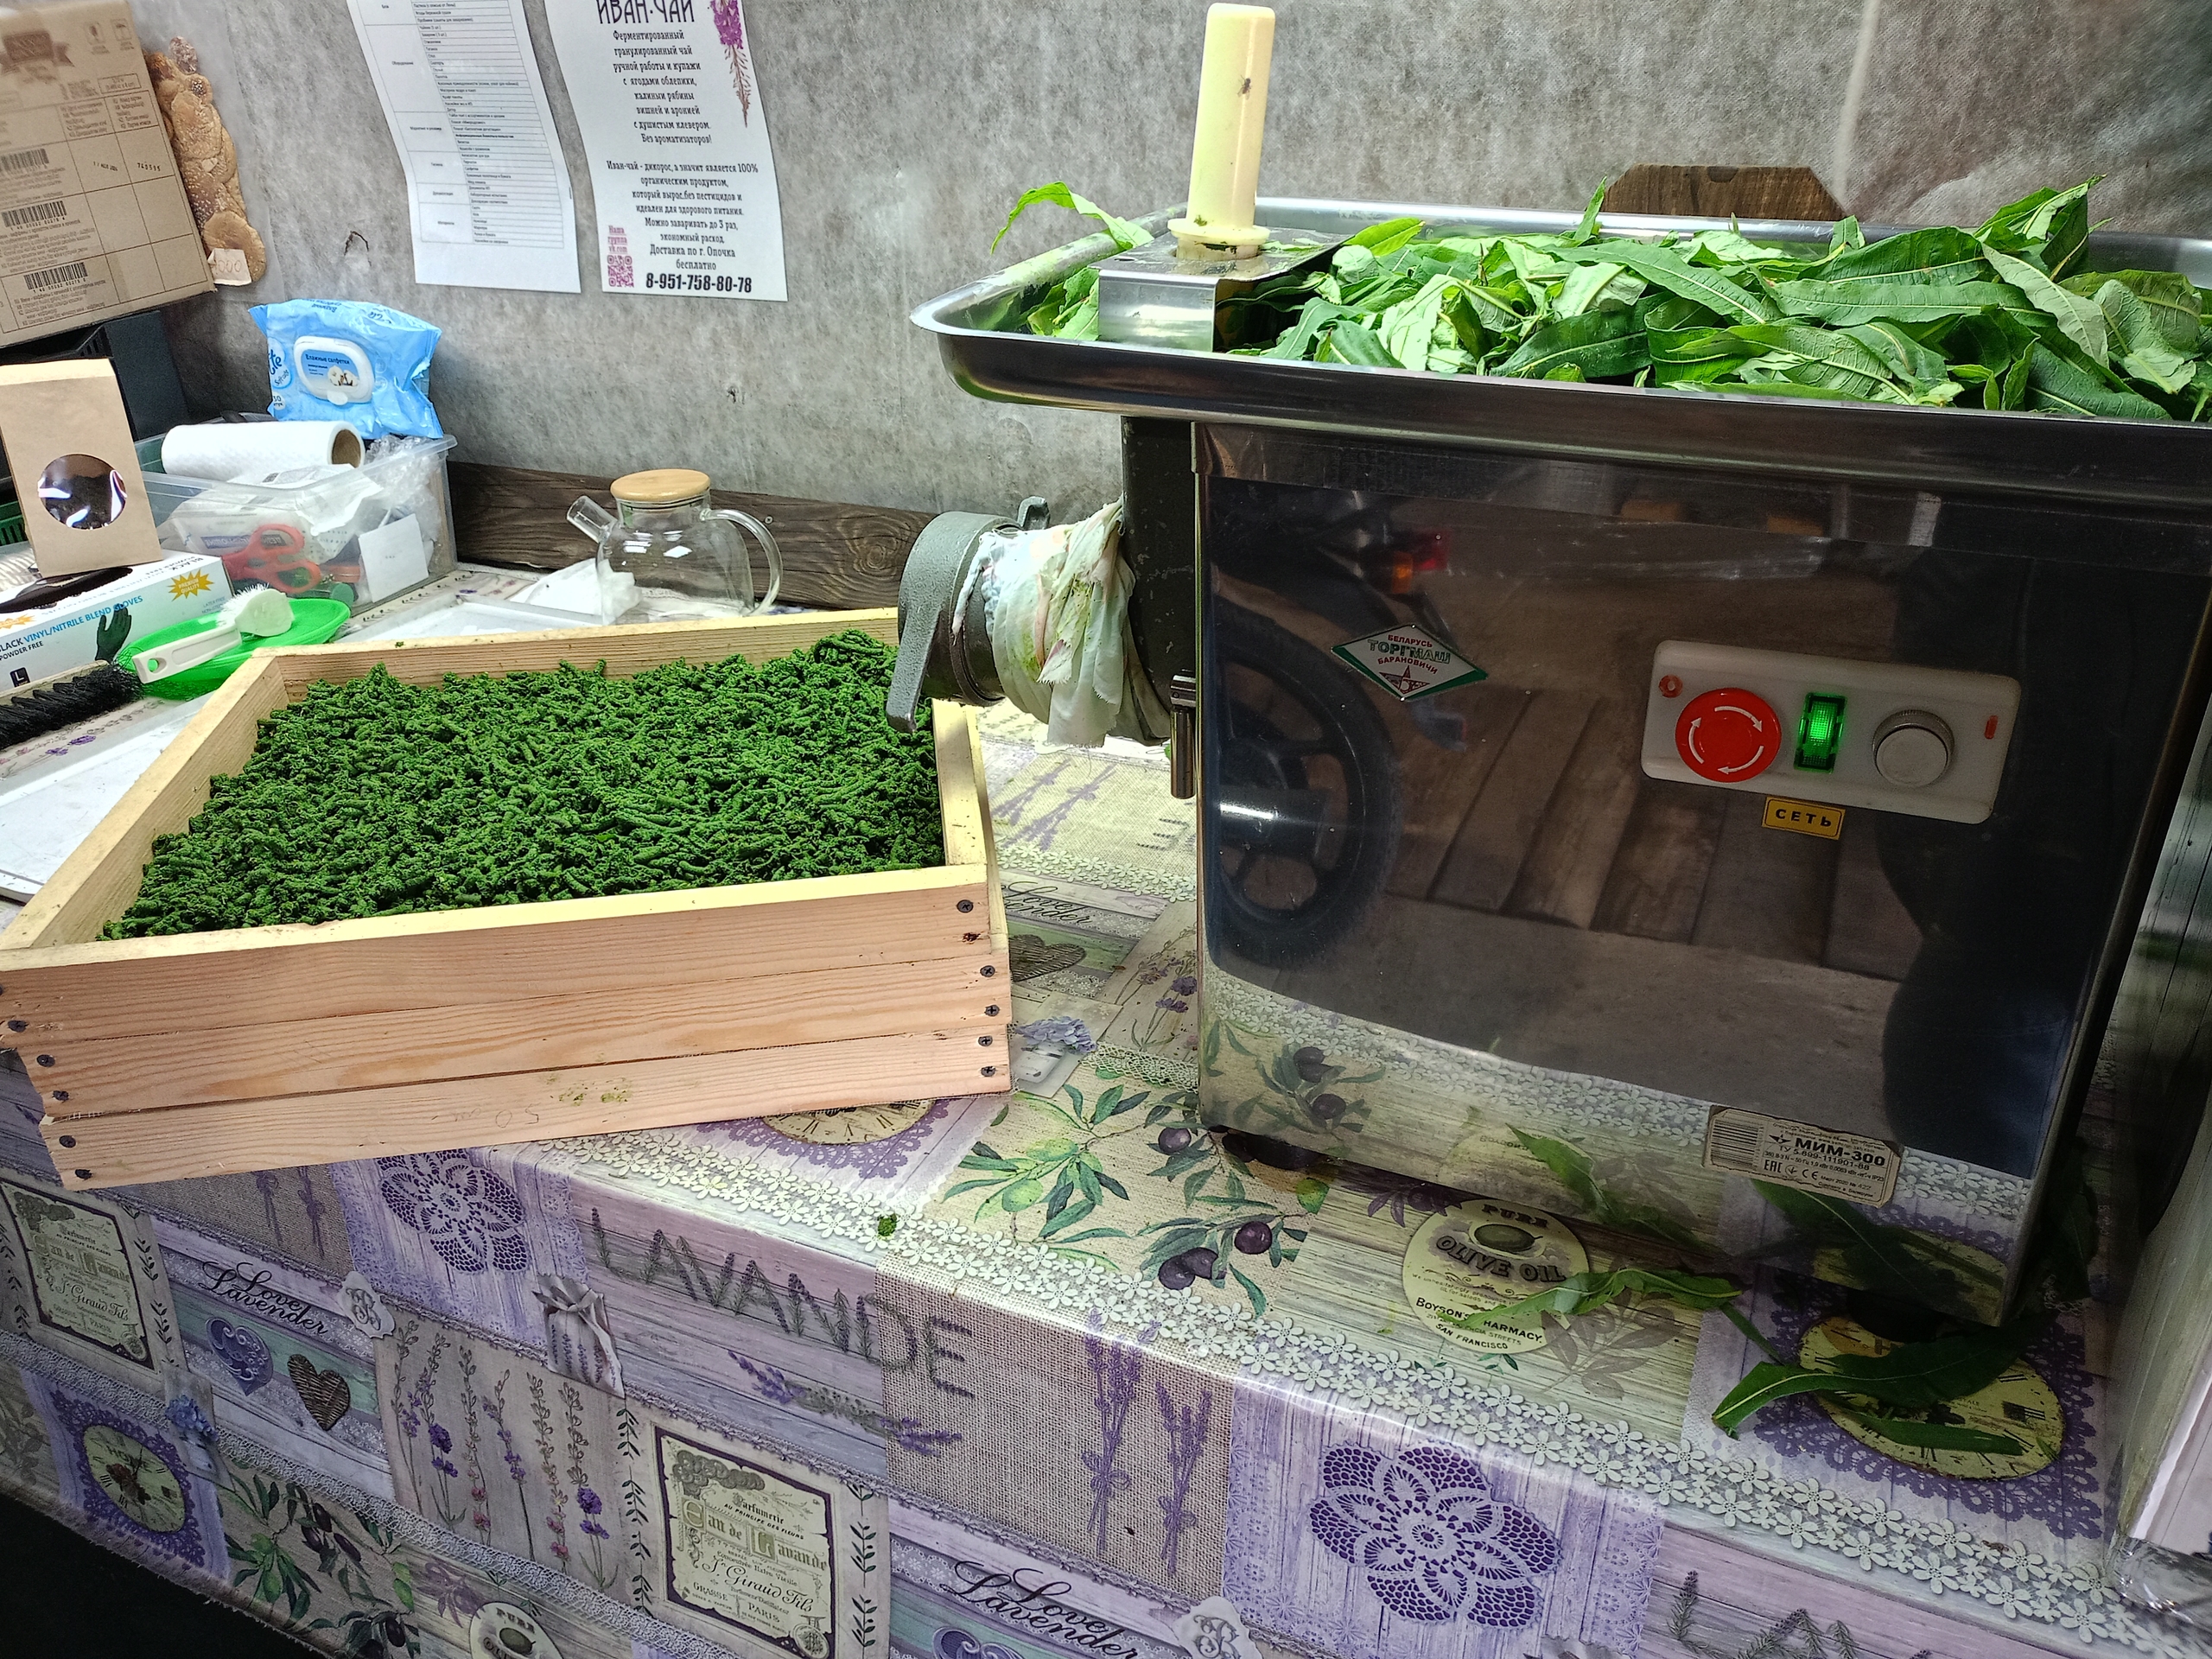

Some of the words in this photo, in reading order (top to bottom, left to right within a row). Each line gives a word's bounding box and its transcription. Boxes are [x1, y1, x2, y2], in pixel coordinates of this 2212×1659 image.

[613, 30, 684, 42] Ферментированный
[614, 46, 677, 58] гранулированный
[678, 45, 693, 55] чай
[613, 61, 639, 73] ручной
[639, 60, 665, 73] работы
[673, 62, 701, 73] купажи
[630, 78, 660, 86] ягодами
[661, 76, 697, 86] облепихи,
[667, 91, 695, 102] рябины
[636, 105, 664, 115] вишней
[665, 105, 670, 114] и
[671, 105, 700, 117] аронией
[639, 121, 674, 130] душистым
[676, 122, 711, 131] клевером.
[641, 133, 653, 143] Без
[654, 134, 712, 145] ароматизаторов!
[607, 160, 639, 170] Иван-чай
[645, 162, 674, 173] дикорос,
[705, 164, 737, 173] является
[738, 163, 759, 173] 100%
[640, 176, 689, 187] органическим
[690, 178, 729, 188] продуктом,
[632, 190, 662, 200] который
[696, 193, 735, 202] пестицидов
[636, 204, 664, 213] идеален
[664, 206, 677, 214] для
[678, 206, 712, 216] здорового
[608, 226, 625, 234] Наша
[645, 217, 669, 227] Можно
[671, 219, 708, 230] заваривать
[709, 221, 718, 230] до
[719, 219, 723, 229] 3
[726, 221, 738, 232] раз,
[607, 236, 627, 245] группа
[660, 232, 699, 242] экономный
[608, 245, 627, 253] vk.com
[650, 244, 686, 256] Доставка
[687, 246, 696, 256] по
[707, 246, 736, 257] Опочка
[676, 259, 716, 270] бесплатно
[645, 272, 753, 293] 8-951-758-80-78
[305, 353, 327, 362] Влажные
[328, 355, 350, 365] салфетки
[23, 615, 85, 643] VINYL/NITRILE
[85, 607, 111, 621] BLEND
[112, 595, 143, 613] GLOVES
[28, 640, 44, 651] FREE
[1388, 634, 1433, 647] БЕЛАРУСЬ
[1367, 639, 1451, 664] ТОРГМАШ
[1377, 658, 1438, 674] БАРАНОВИЧИ
[15, 671, 25, 682] L
[1775, 808, 1832, 828] СЕТЬ
[1795, 1137, 1885, 1166] МИМ-300
[1793, 1148, 1870, 1171] 5.899-111901-88
[1481, 1204, 1549, 1228] PURE
[1436, 1236, 1512, 1278] OLIVE
[1519, 1263, 1567, 1282] OIL
[231, 1262, 302, 1313] Love
[71, 1284, 108, 1312] Giraud
[108, 1303, 130, 1322] Fils
[198, 1261, 328, 1335] Lavender
[1435, 1324, 1453, 1338] SAN
[1456, 1333, 1509, 1350] FRANCISCO
[1483, 1319, 1542, 1344] HARMACY.
[1488, 1331, 1522, 1345] STREETS
[733, 1491, 785, 1524] Parfumerie
[734, 1509, 765, 1525] PRINCIPE
[781, 1528, 804, 1540] FLEURS
[728, 1524, 742, 1541] de
[693, 1581, 728, 1601] GRASSE
[724, 1565, 782, 1599] Giraud
[782, 1588, 814, 1612] Fils
[996, 1567, 1108, 1636] Love
[748, 1602, 780, 1623] PARIS
[939, 1560, 1137, 1659] Lavender
